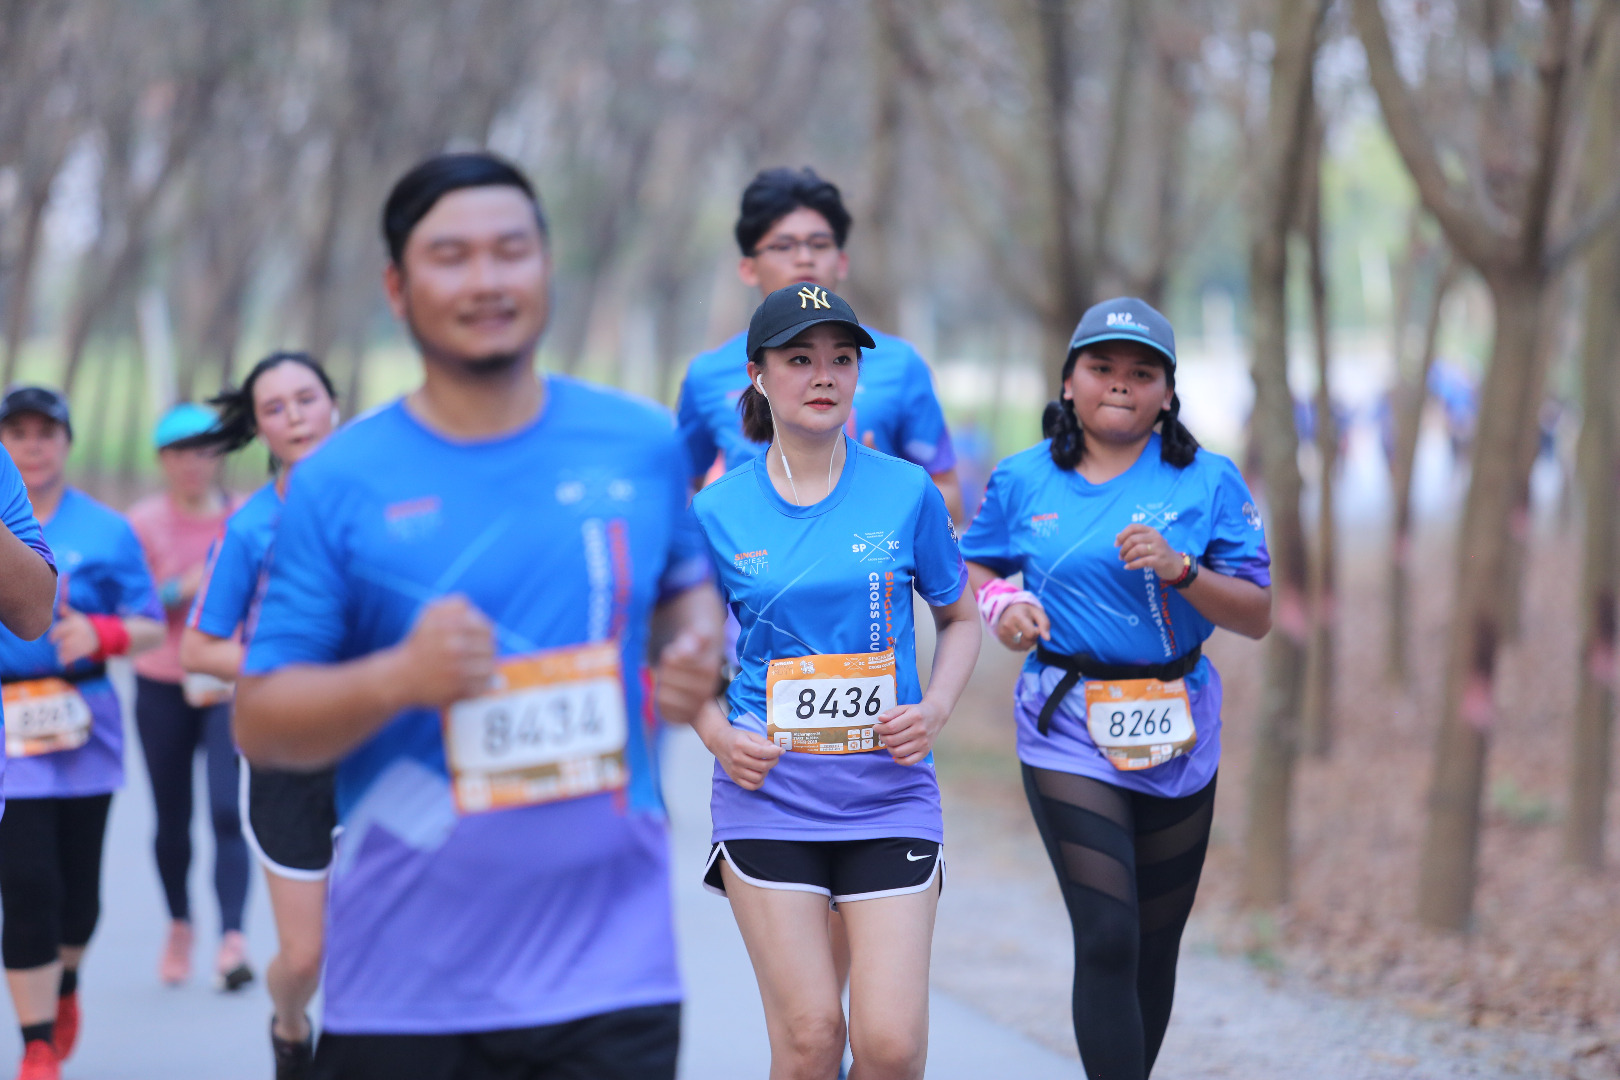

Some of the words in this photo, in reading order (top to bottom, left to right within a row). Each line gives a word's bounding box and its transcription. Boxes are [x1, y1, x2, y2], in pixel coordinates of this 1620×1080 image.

[797, 286, 831, 309] NY
[1131, 513, 1146, 522] SP
[1164, 511, 1178, 521] XC
[734, 549, 768, 563] SINGHA
[852, 543, 867, 553] SP
[886, 540, 900, 550] XC
[869, 571, 880, 619] CROSS
[884, 571, 894, 633] SINGHA
[795, 685, 881, 719] 8436
[483, 688, 604, 757] 8434
[1109, 708, 1171, 737] 8266
